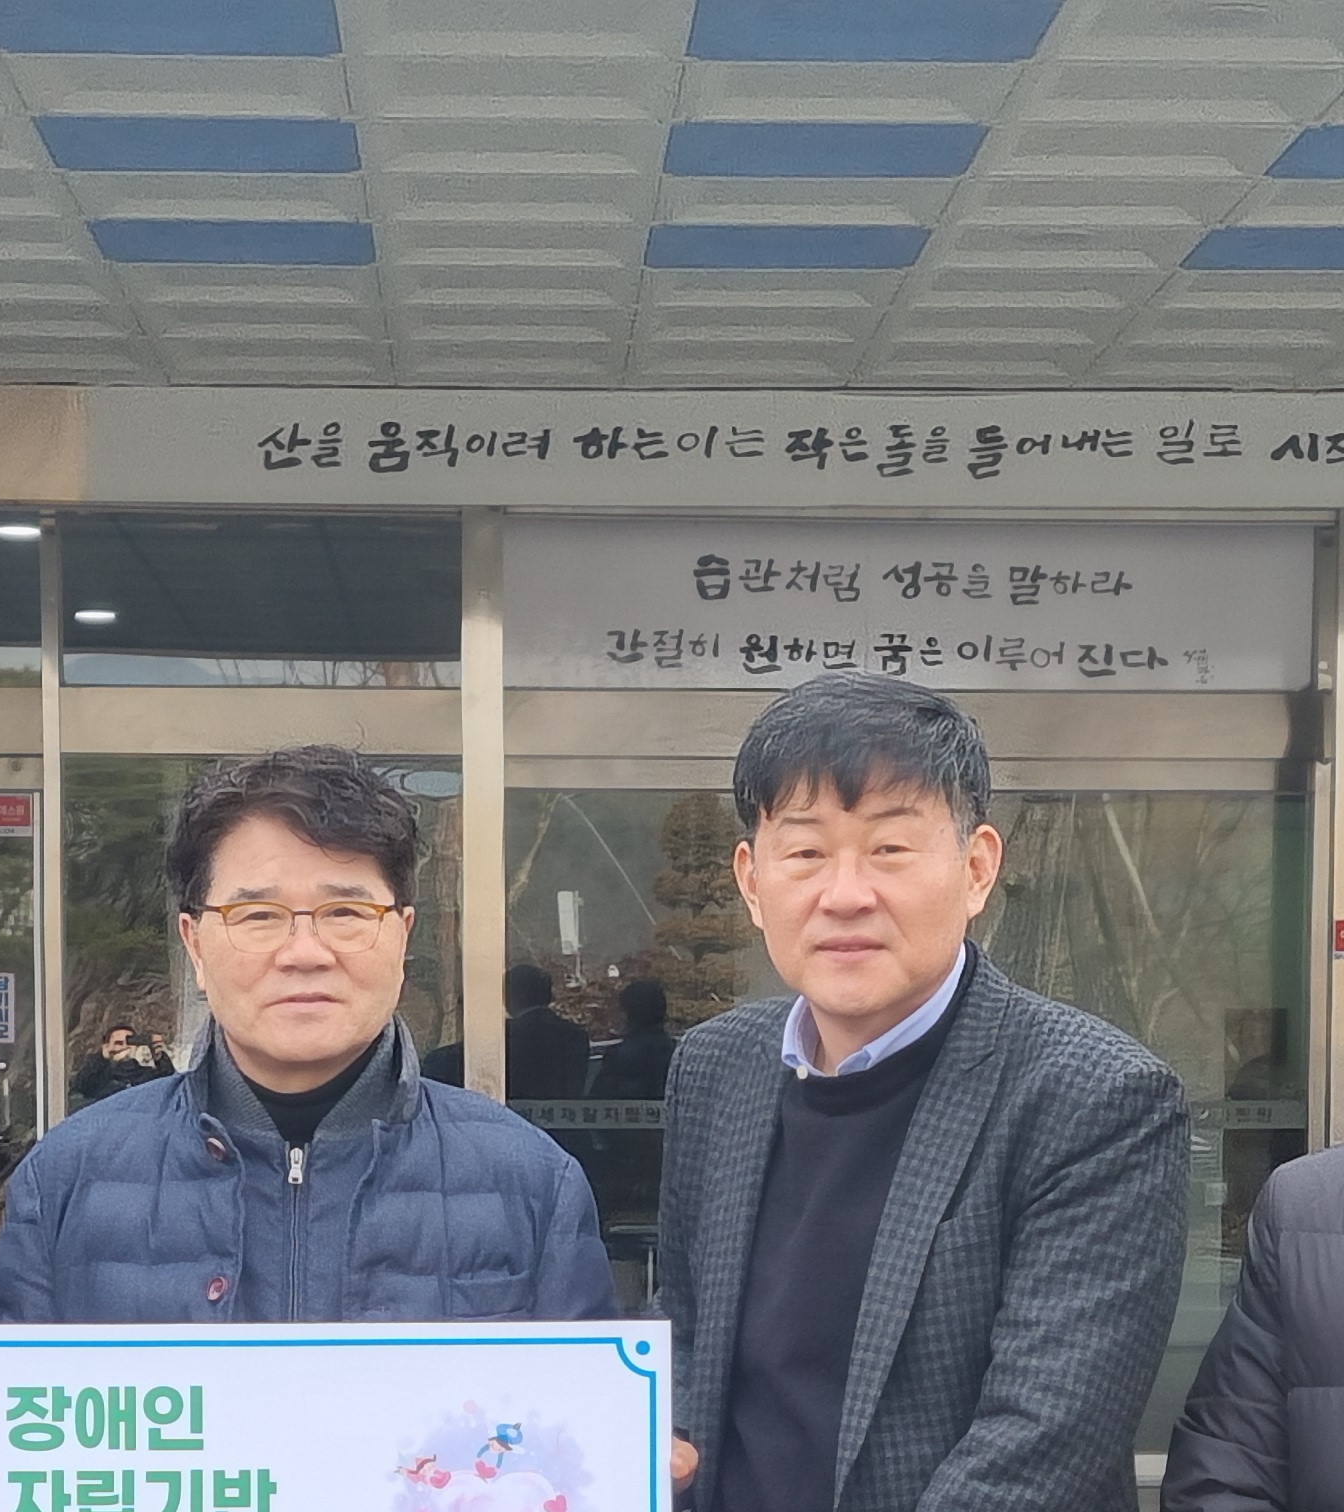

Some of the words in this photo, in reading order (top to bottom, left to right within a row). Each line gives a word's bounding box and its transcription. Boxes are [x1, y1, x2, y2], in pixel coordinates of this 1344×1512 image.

[257, 422, 342, 470] 산을
[367, 422, 551, 473] 움직이려
[966, 424, 1133, 480] 들어내는
[1156, 419, 1242, 465] 일로
[692, 553, 860, 602] 습관처럼
[881, 560, 992, 600] 성공을
[1009, 564, 1133, 605] 말하라
[606, 628, 720, 669] 간절히
[738, 633, 858, 675] 원하면
[872, 633, 944, 676] 꿈은
[5, 1385, 205, 1452] 장애인
